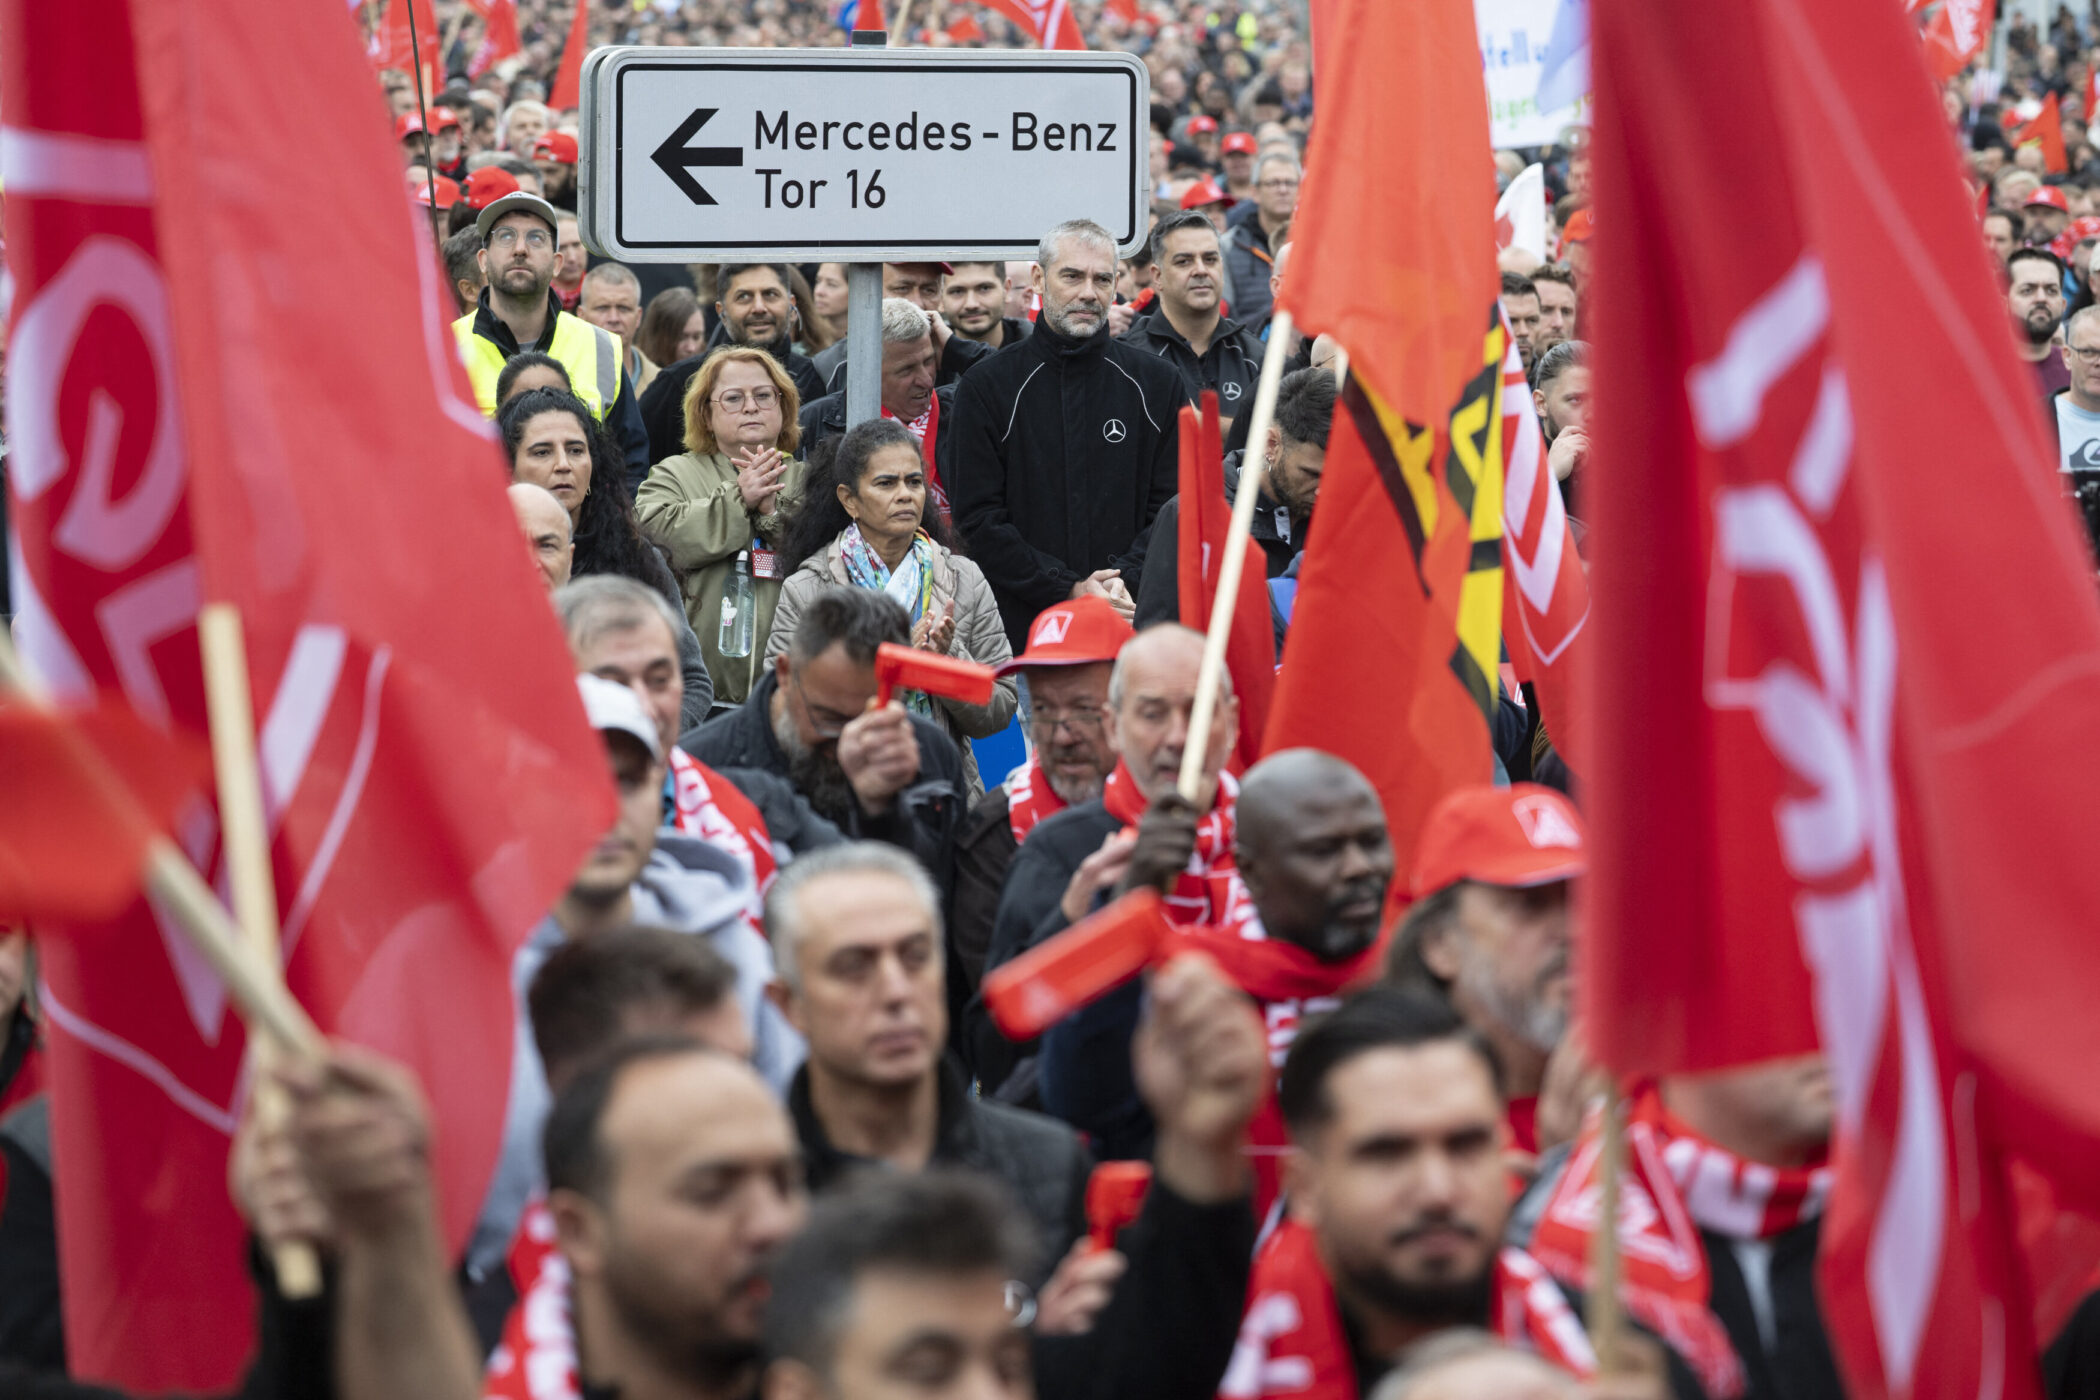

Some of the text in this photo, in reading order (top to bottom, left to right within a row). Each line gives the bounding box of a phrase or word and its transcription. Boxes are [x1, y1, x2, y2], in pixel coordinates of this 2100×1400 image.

[755, 110, 1118, 152] Mercedes-Benz
[754, 168, 887, 209] Tor 16
